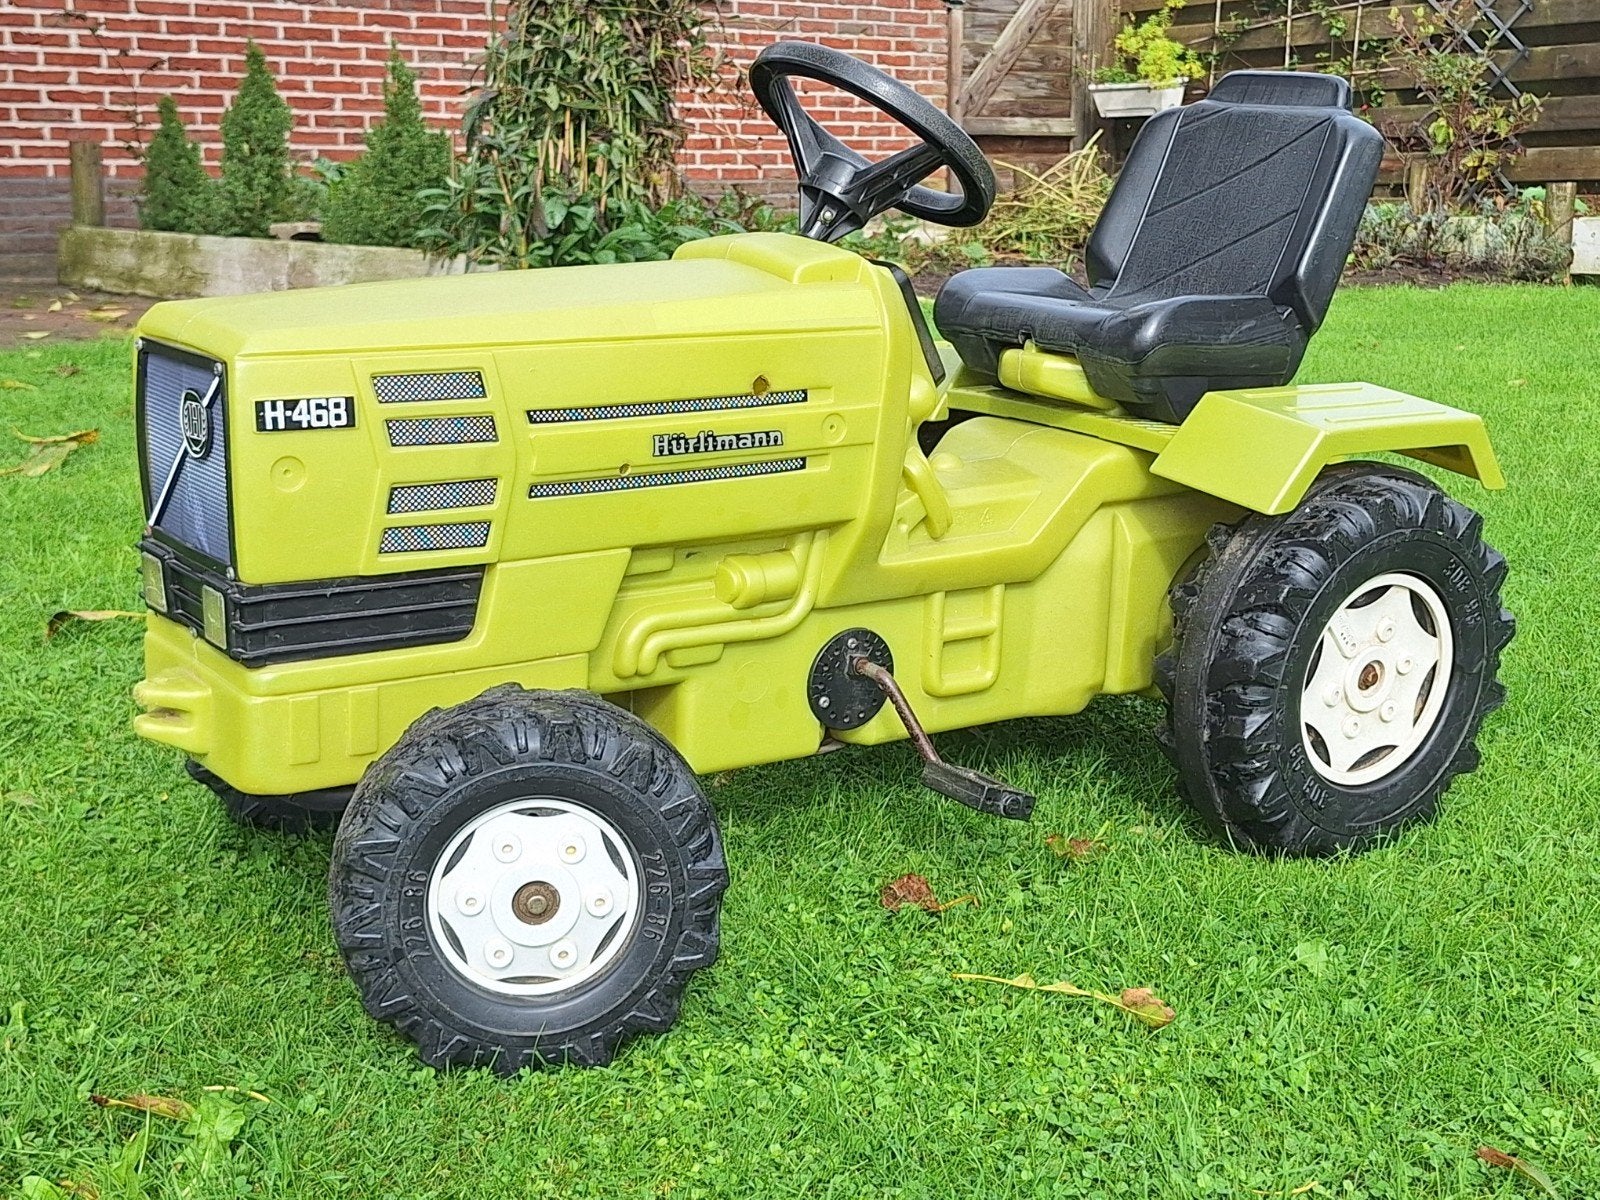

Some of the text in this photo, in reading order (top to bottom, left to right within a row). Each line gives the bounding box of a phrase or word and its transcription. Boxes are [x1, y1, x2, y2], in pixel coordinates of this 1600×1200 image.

[264, 397, 348, 430] H-468
[652, 430, 784, 457] Hürlimann
[641, 849, 670, 941] 226-86
